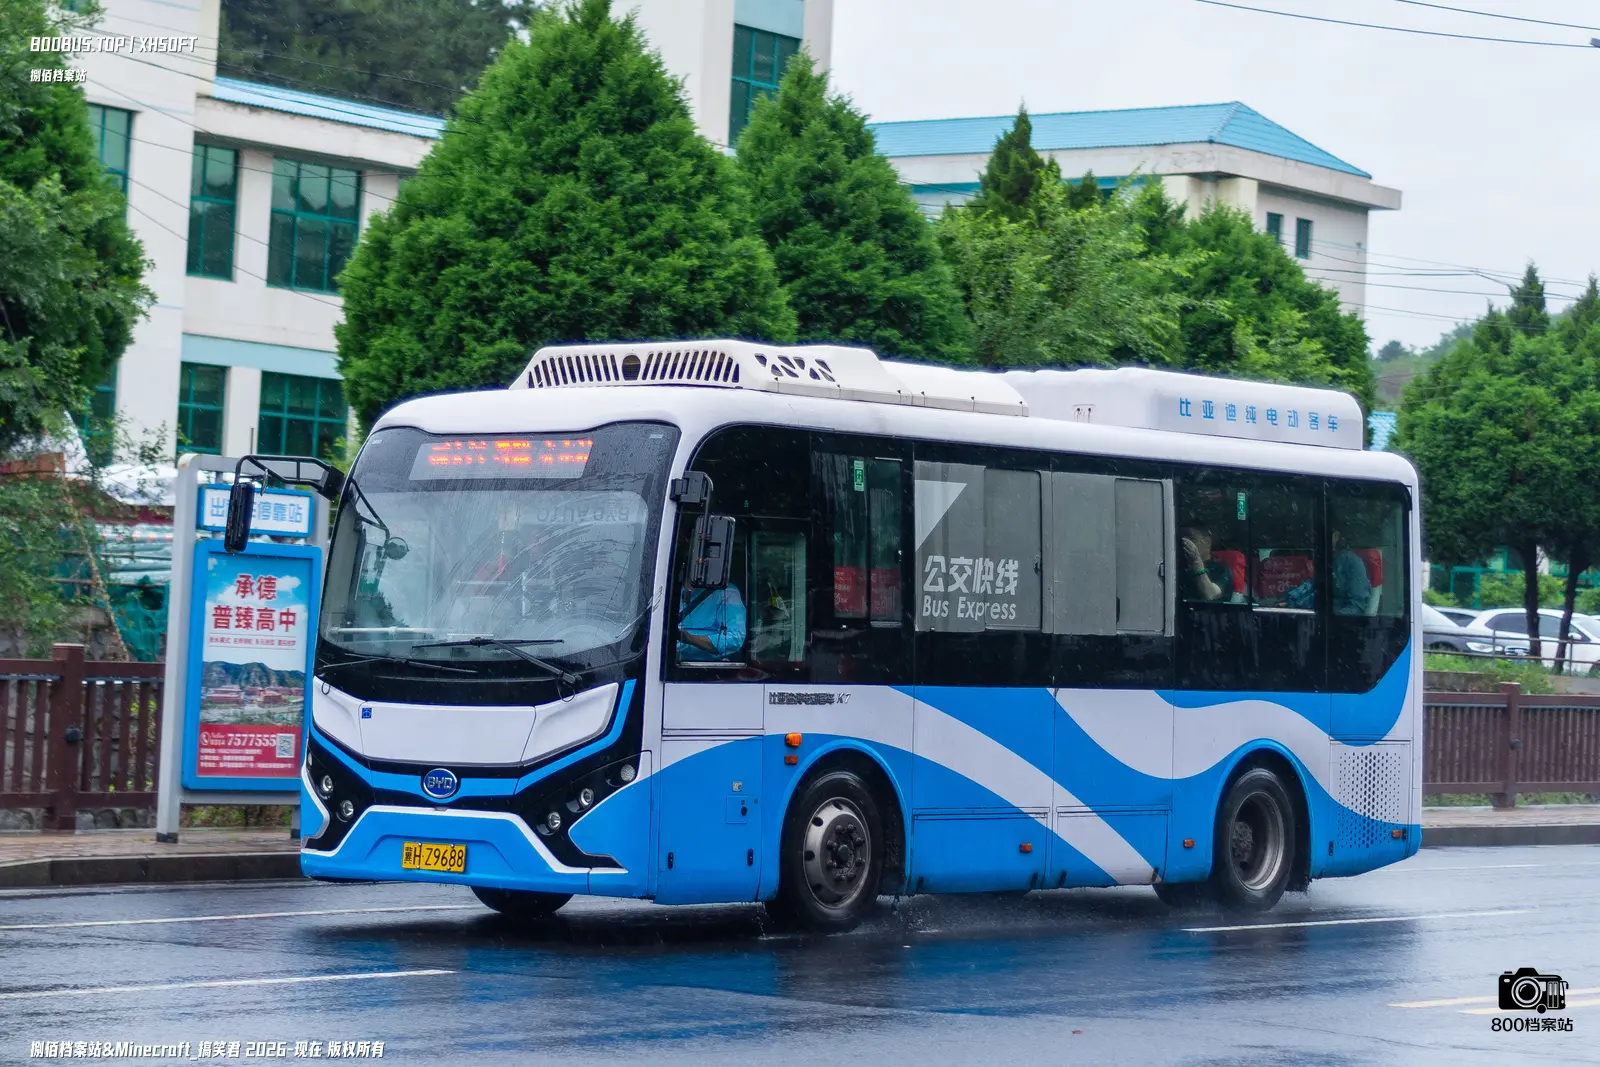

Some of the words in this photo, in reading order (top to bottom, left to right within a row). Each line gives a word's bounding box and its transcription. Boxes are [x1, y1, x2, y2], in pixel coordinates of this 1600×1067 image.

[1179, 397, 1339, 433] 比亚迪纯电动客车
[210, 497, 303, 523] 出停靠站
[235, 574, 277, 600] 承德
[923, 555, 1019, 595] 公交快线
[212, 605, 297, 632] 普臻高中
[923, 595, 949, 617] Bus
[957, 596, 1017, 620] Express
[836, 692, 852, 704] K7
[227, 733, 277, 747] 7577555
[427, 776, 453, 790] BYD
